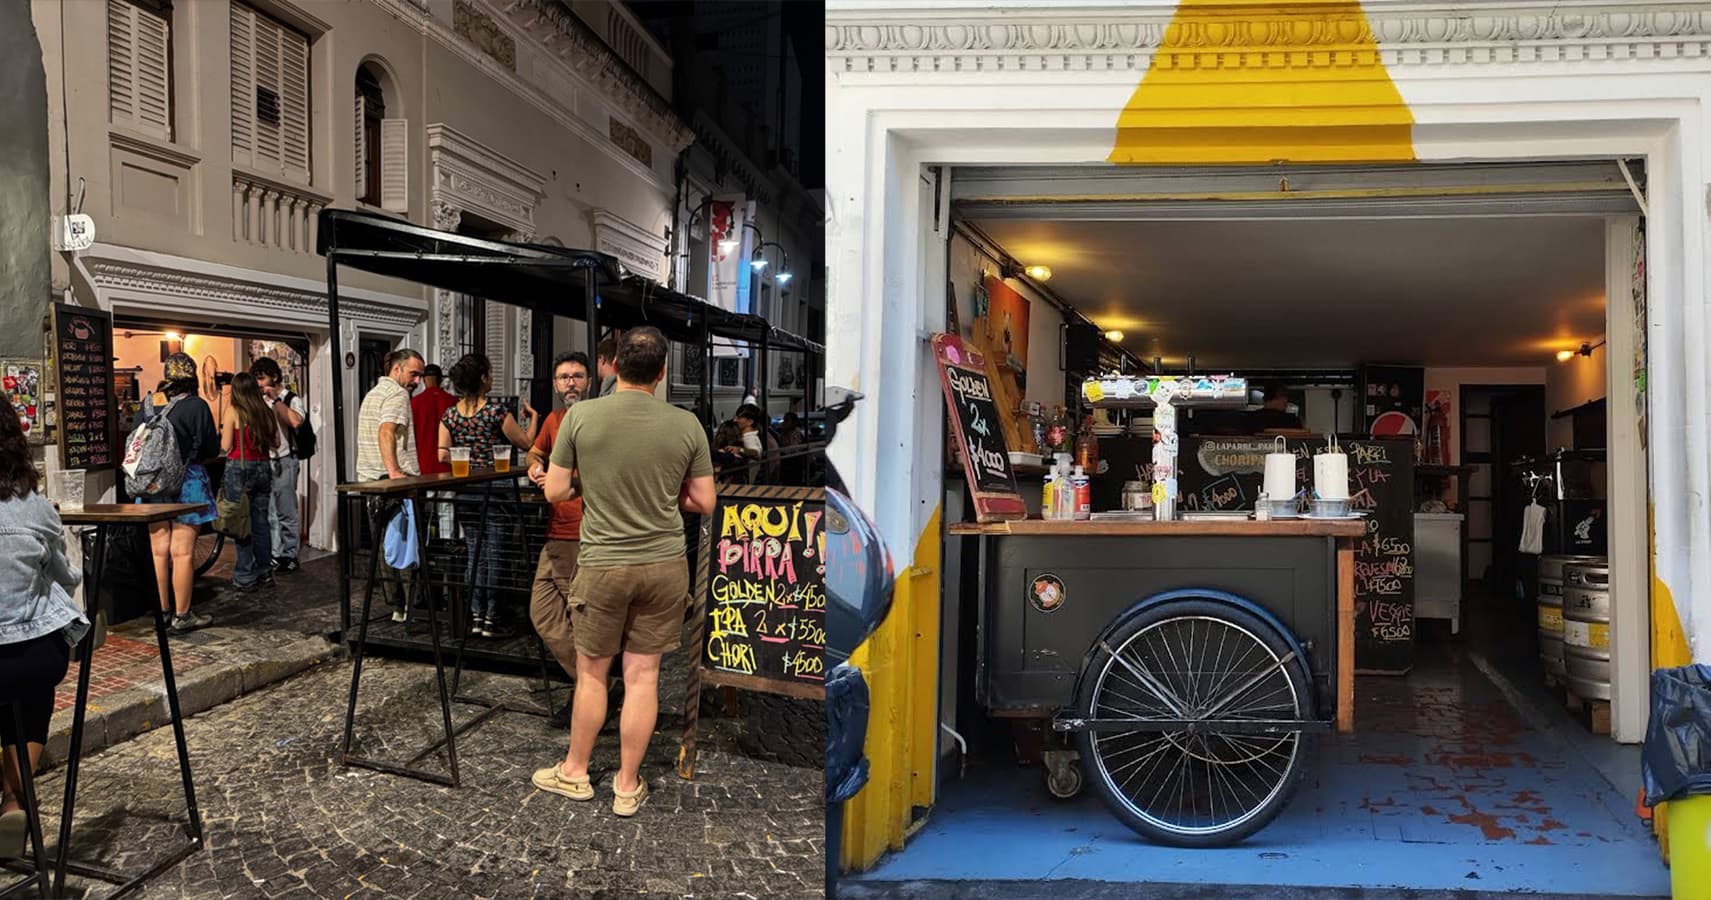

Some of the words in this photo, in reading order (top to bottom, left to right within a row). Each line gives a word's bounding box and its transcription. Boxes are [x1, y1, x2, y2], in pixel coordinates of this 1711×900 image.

[947, 367, 991, 404] GOLDEN
[968, 435, 1005, 480] $4000
[712, 575, 776, 610] GOLDEN
[709, 607, 748, 637] IPA
[1370, 600, 1412, 625] VEGGIE
[707, 635, 757, 672] CHORI
[782, 650, 823, 677] $4500
